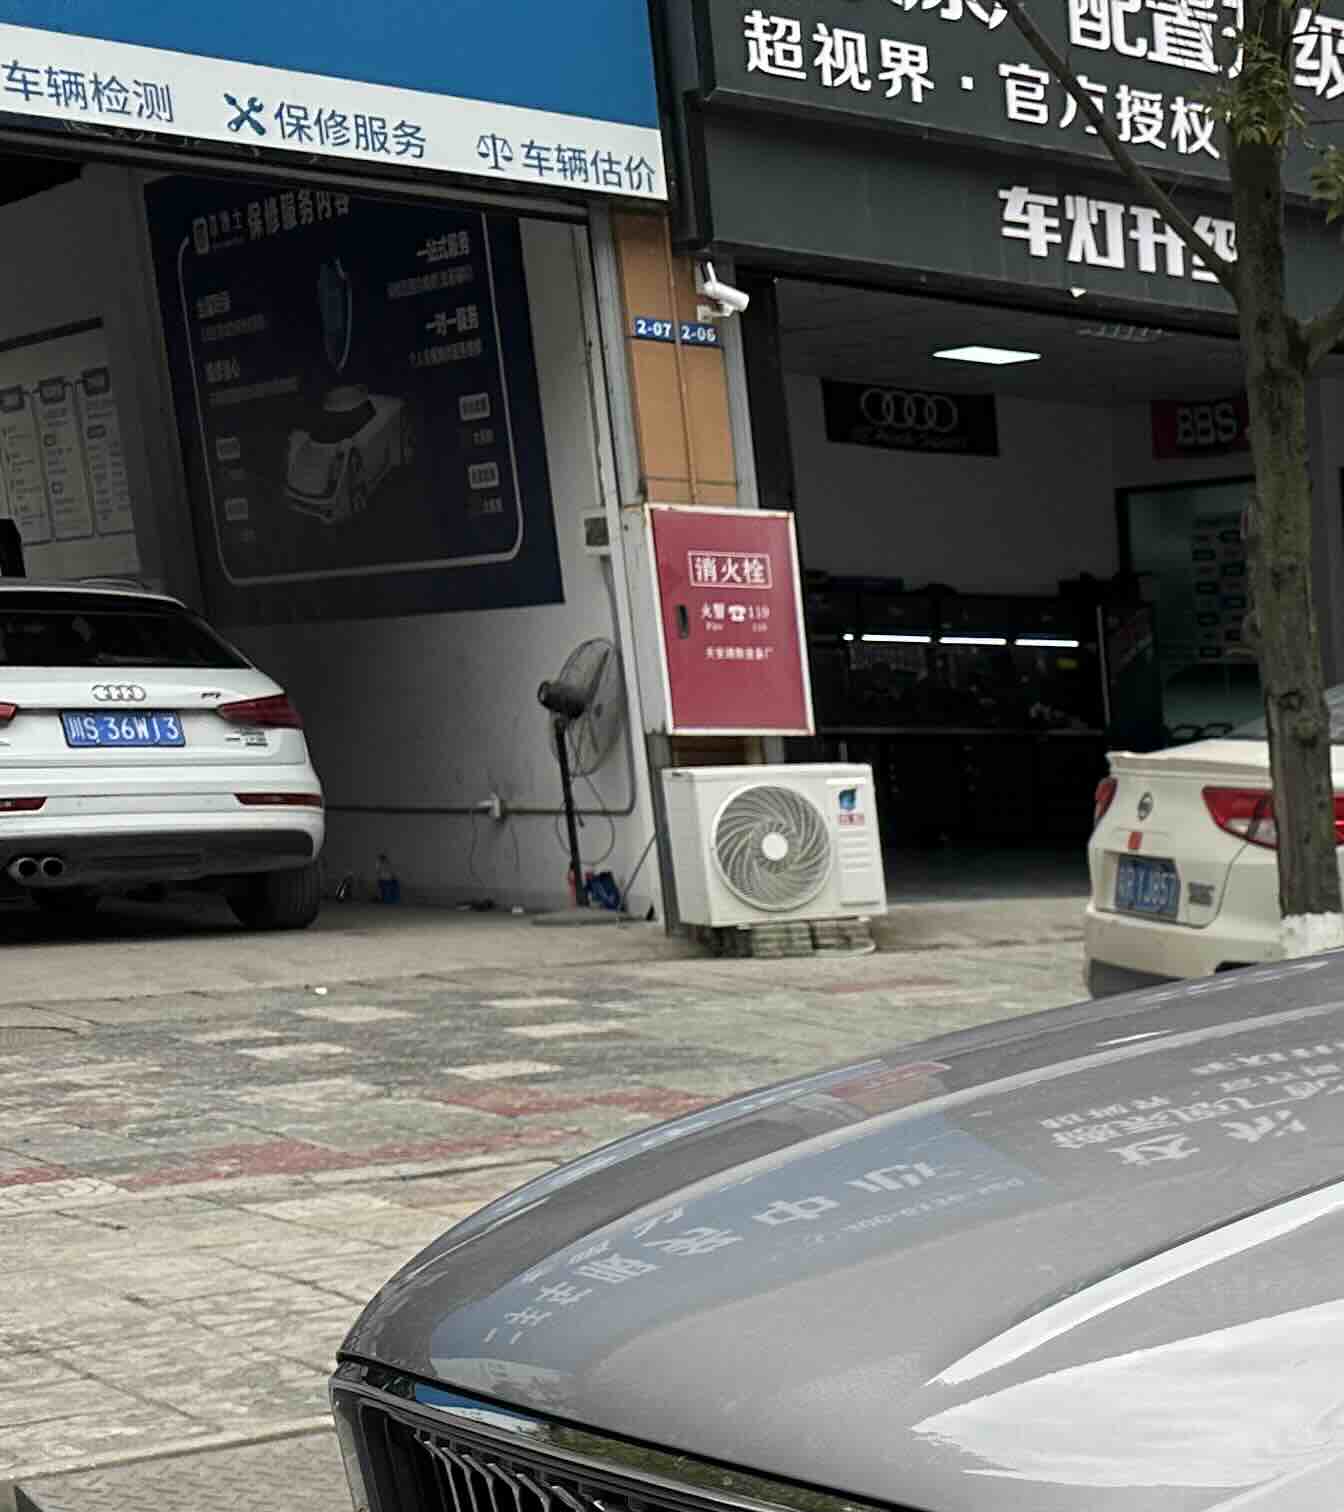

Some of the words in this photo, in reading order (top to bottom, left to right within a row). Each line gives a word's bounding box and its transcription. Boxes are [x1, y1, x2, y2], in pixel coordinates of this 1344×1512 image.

[2, 60, 174, 123] 车辆检测
[274, 101, 427, 158] 保修服务
[520, 138, 656, 194] 车辆估价
[636, 319, 672, 337] 2-07
[1176, 401, 1240, 448] BBS
[695, 556, 766, 584] 消火栓
